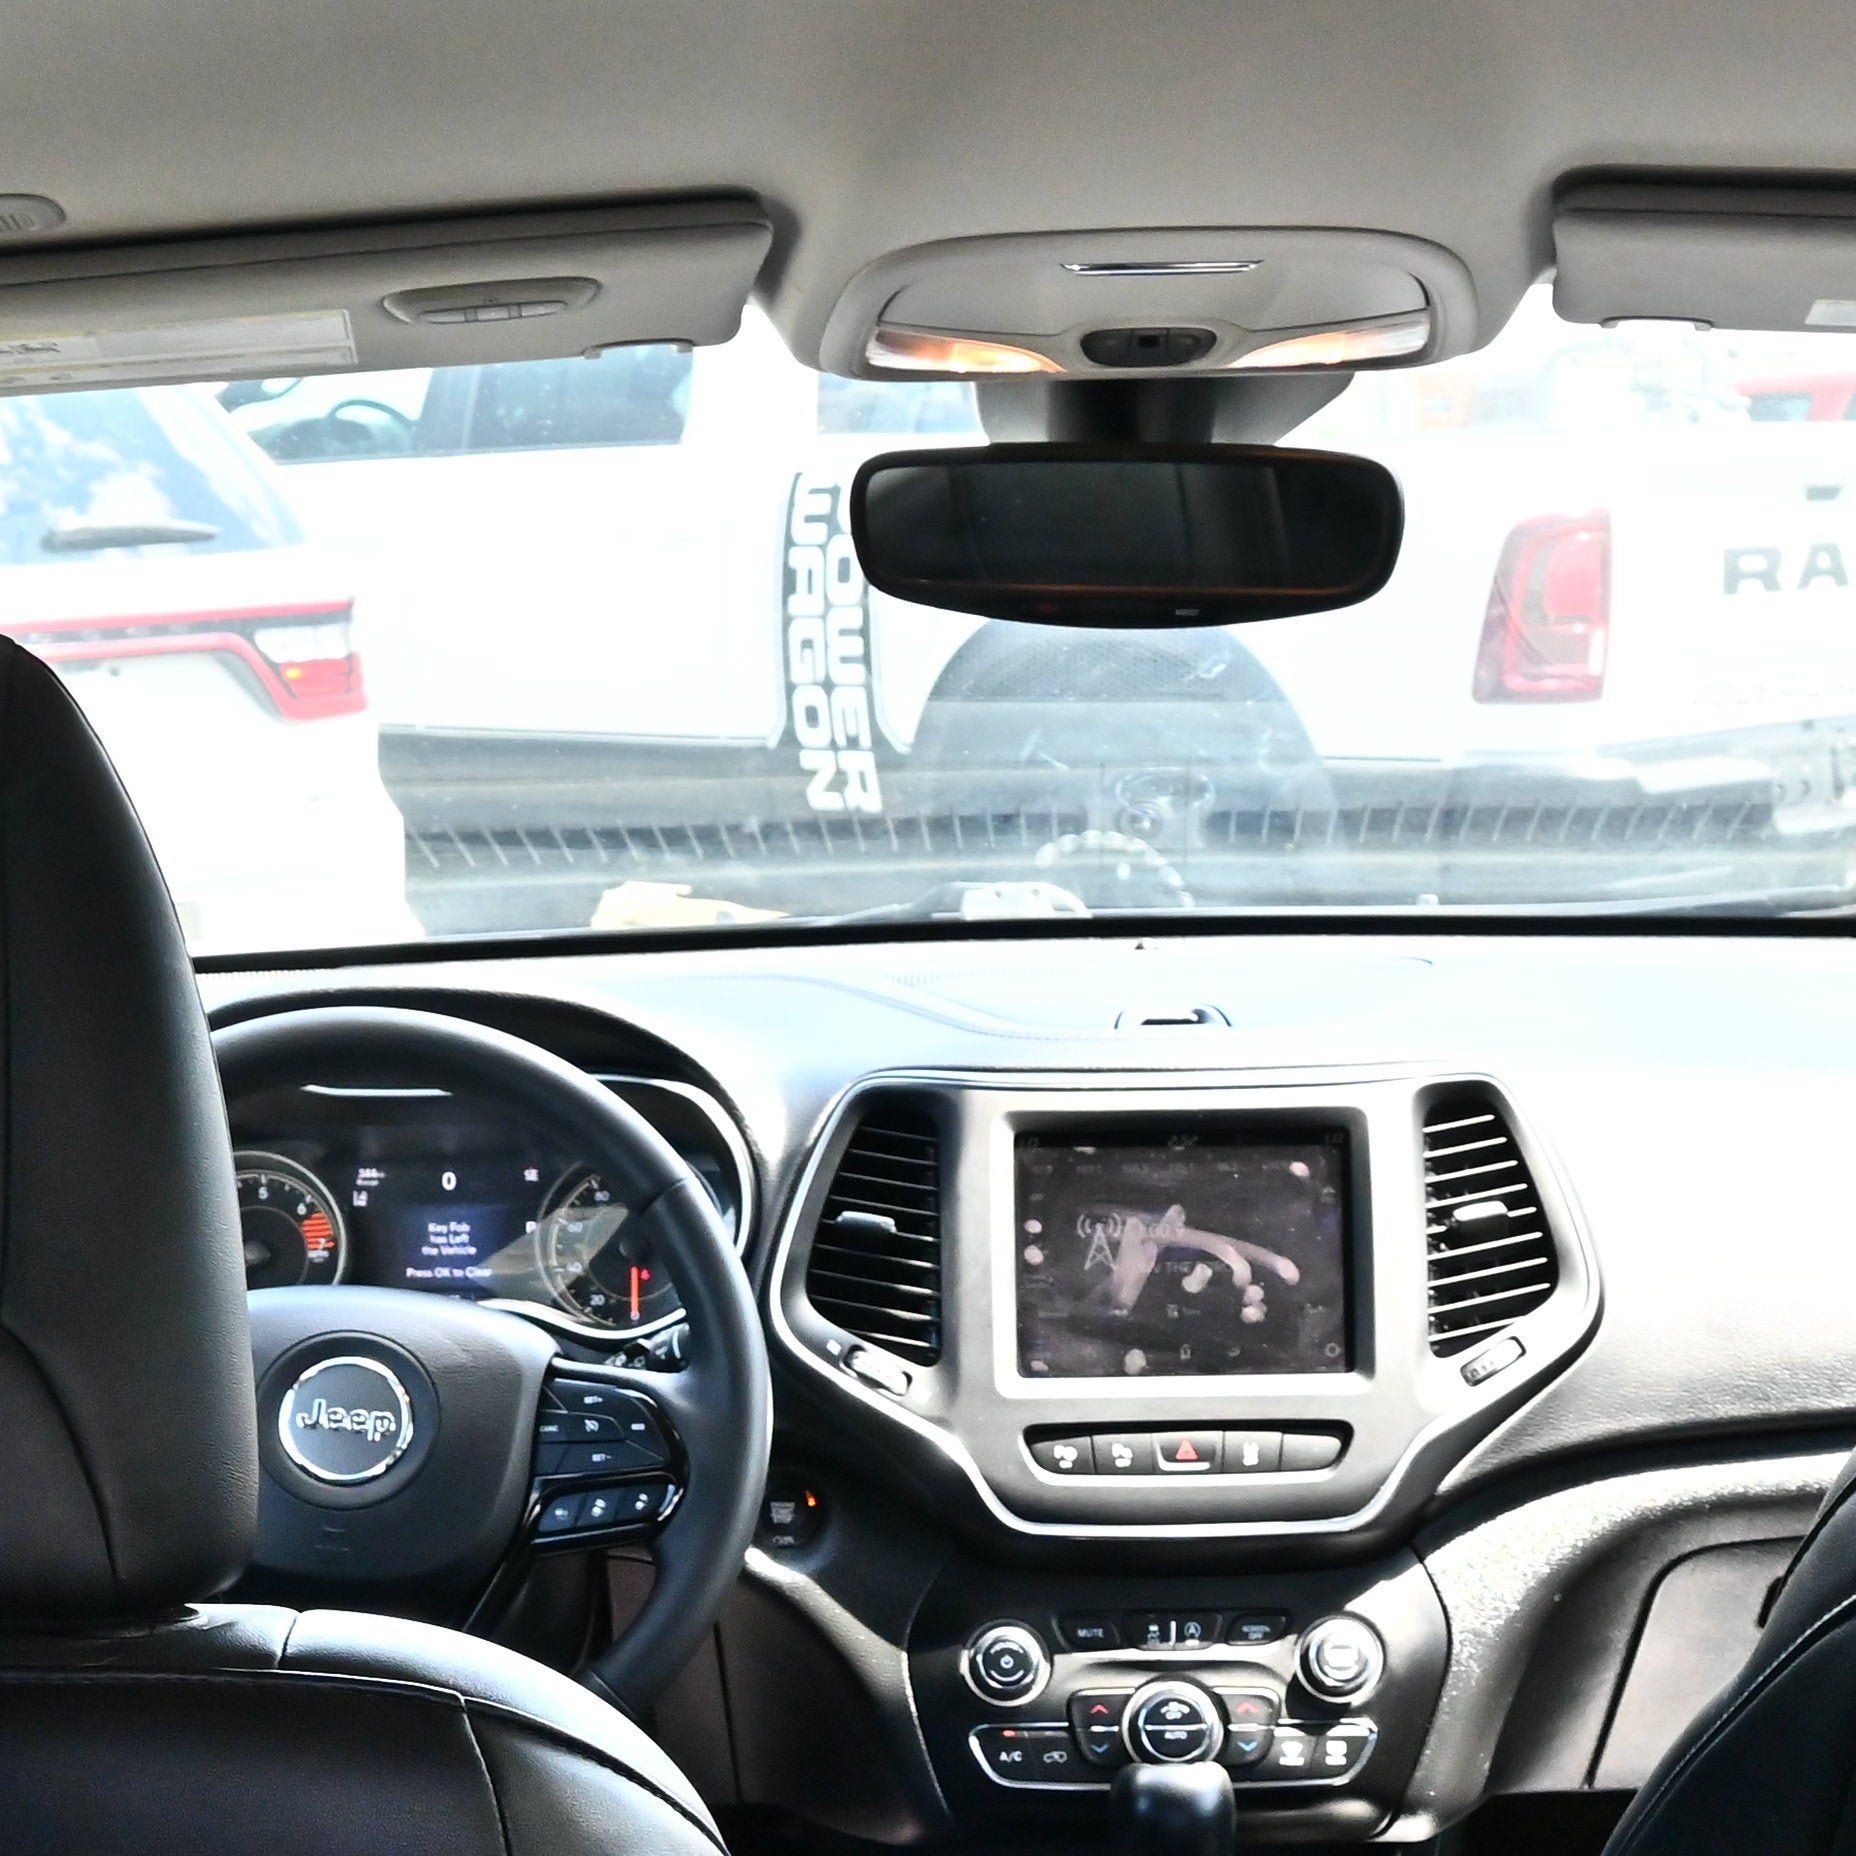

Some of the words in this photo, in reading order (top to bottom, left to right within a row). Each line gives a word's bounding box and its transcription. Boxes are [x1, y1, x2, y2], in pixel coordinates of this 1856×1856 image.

[787, 470, 846, 812] WAGON
[441, 1171, 457, 1191] 0
[295, 1398, 396, 1441] Jeep
[1076, 1628, 1105, 1639] MUTE
[999, 1750, 1023, 1763] A/C
